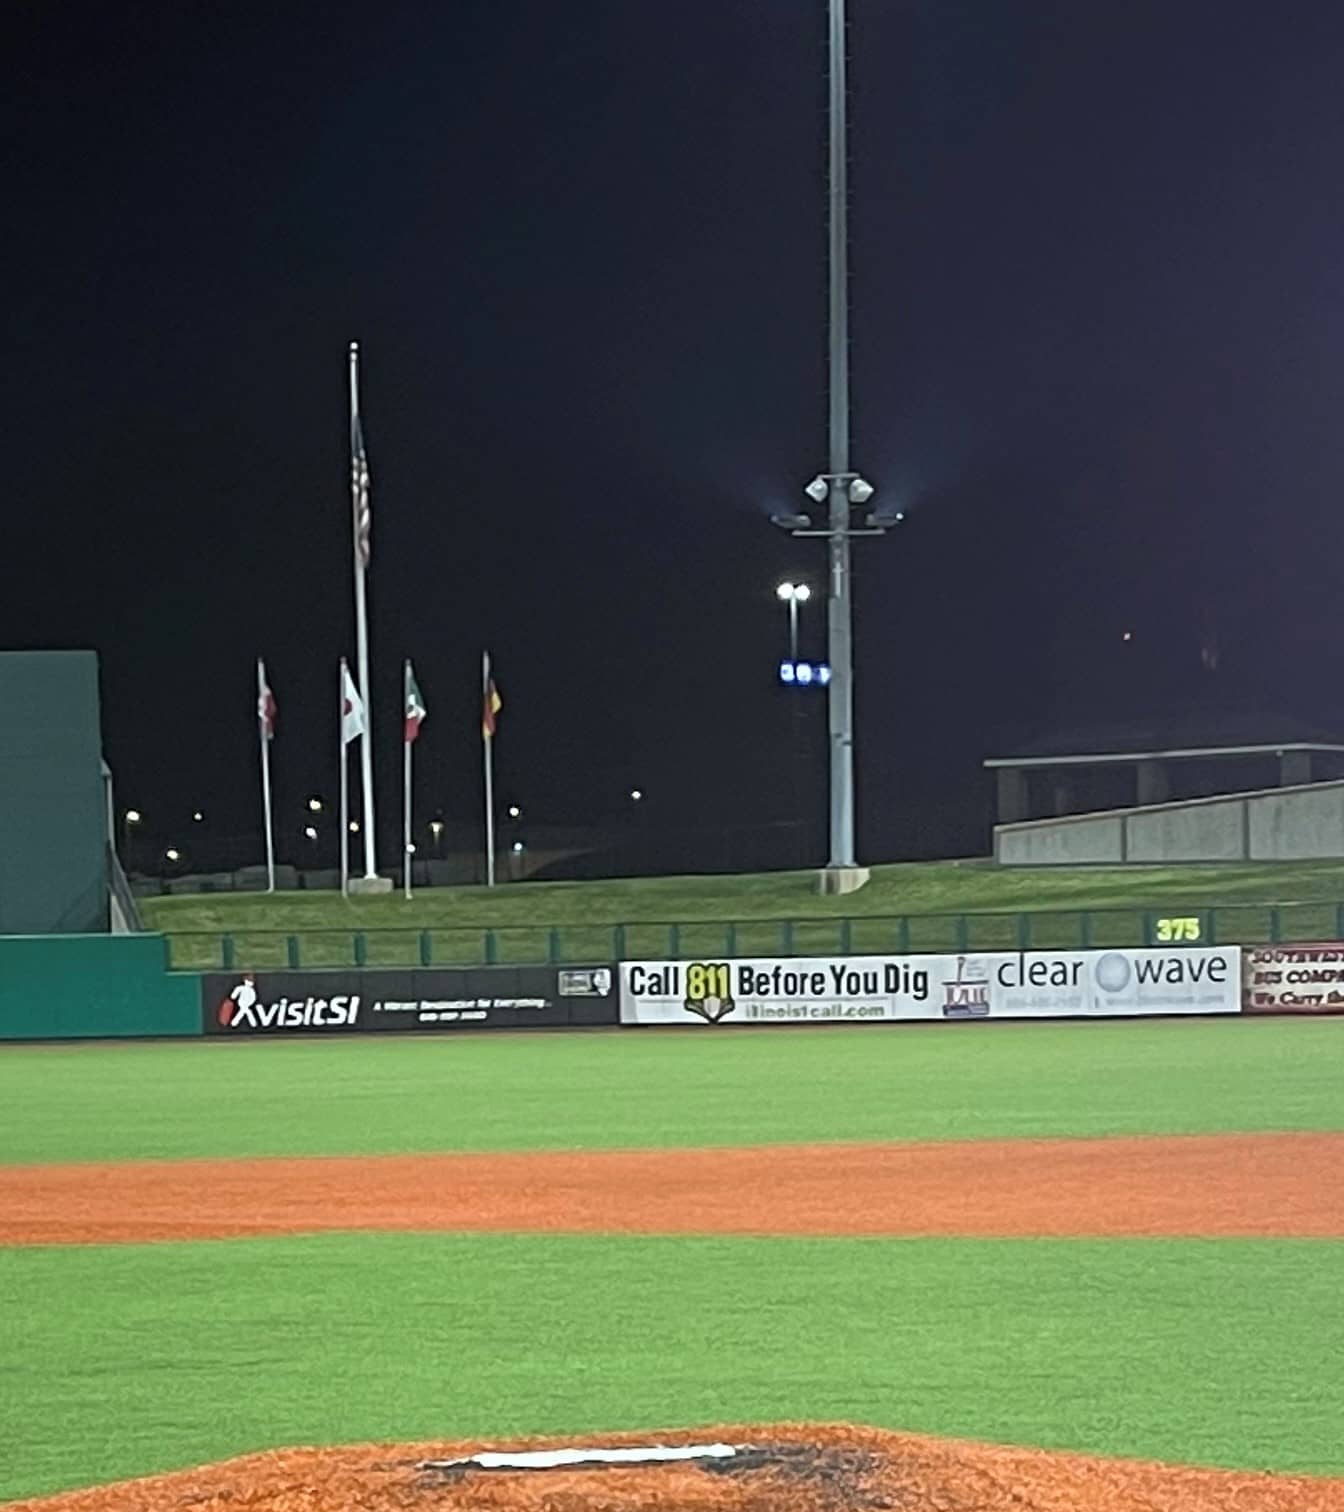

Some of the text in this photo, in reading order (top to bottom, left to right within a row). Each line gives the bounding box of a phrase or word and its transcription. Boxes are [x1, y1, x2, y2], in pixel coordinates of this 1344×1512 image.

[1157, 918, 1200, 941] 375
[629, 965, 679, 996] Call
[686, 963, 730, 999] 811
[738, 964, 825, 996] Before
[830, 964, 878, 995] You
[884, 963, 928, 1000] Dig
[997, 952, 1084, 987] clear
[1135, 956, 1227, 984] wave
[256, 996, 360, 1027] visitSI
